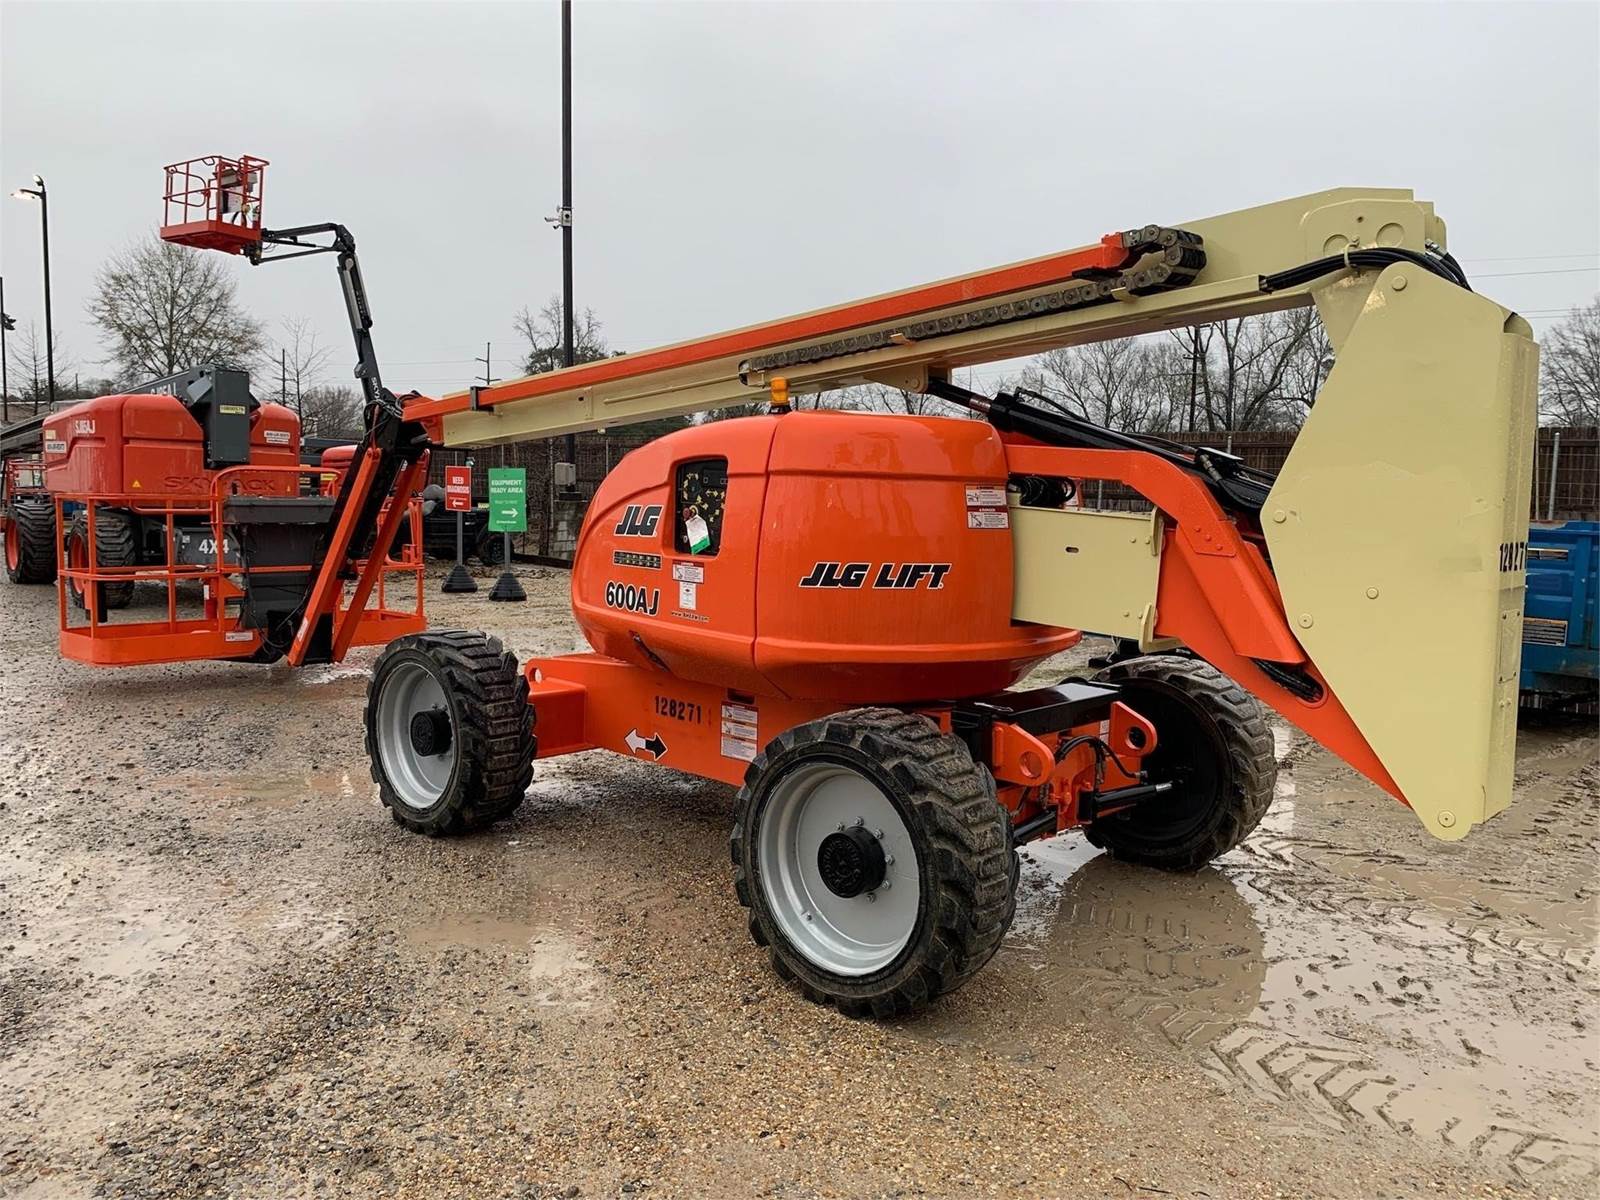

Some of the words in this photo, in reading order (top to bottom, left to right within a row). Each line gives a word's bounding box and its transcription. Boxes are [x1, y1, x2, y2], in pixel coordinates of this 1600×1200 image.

[163, 476, 276, 492] SKYACK
[614, 505, 664, 537] JLG
[199, 539, 229, 554] 4X4
[799, 562, 871, 589] JLG
[873, 563, 952, 589] LIFT
[605, 580, 660, 616] 600AJ
[655, 695, 702, 725] 128271
